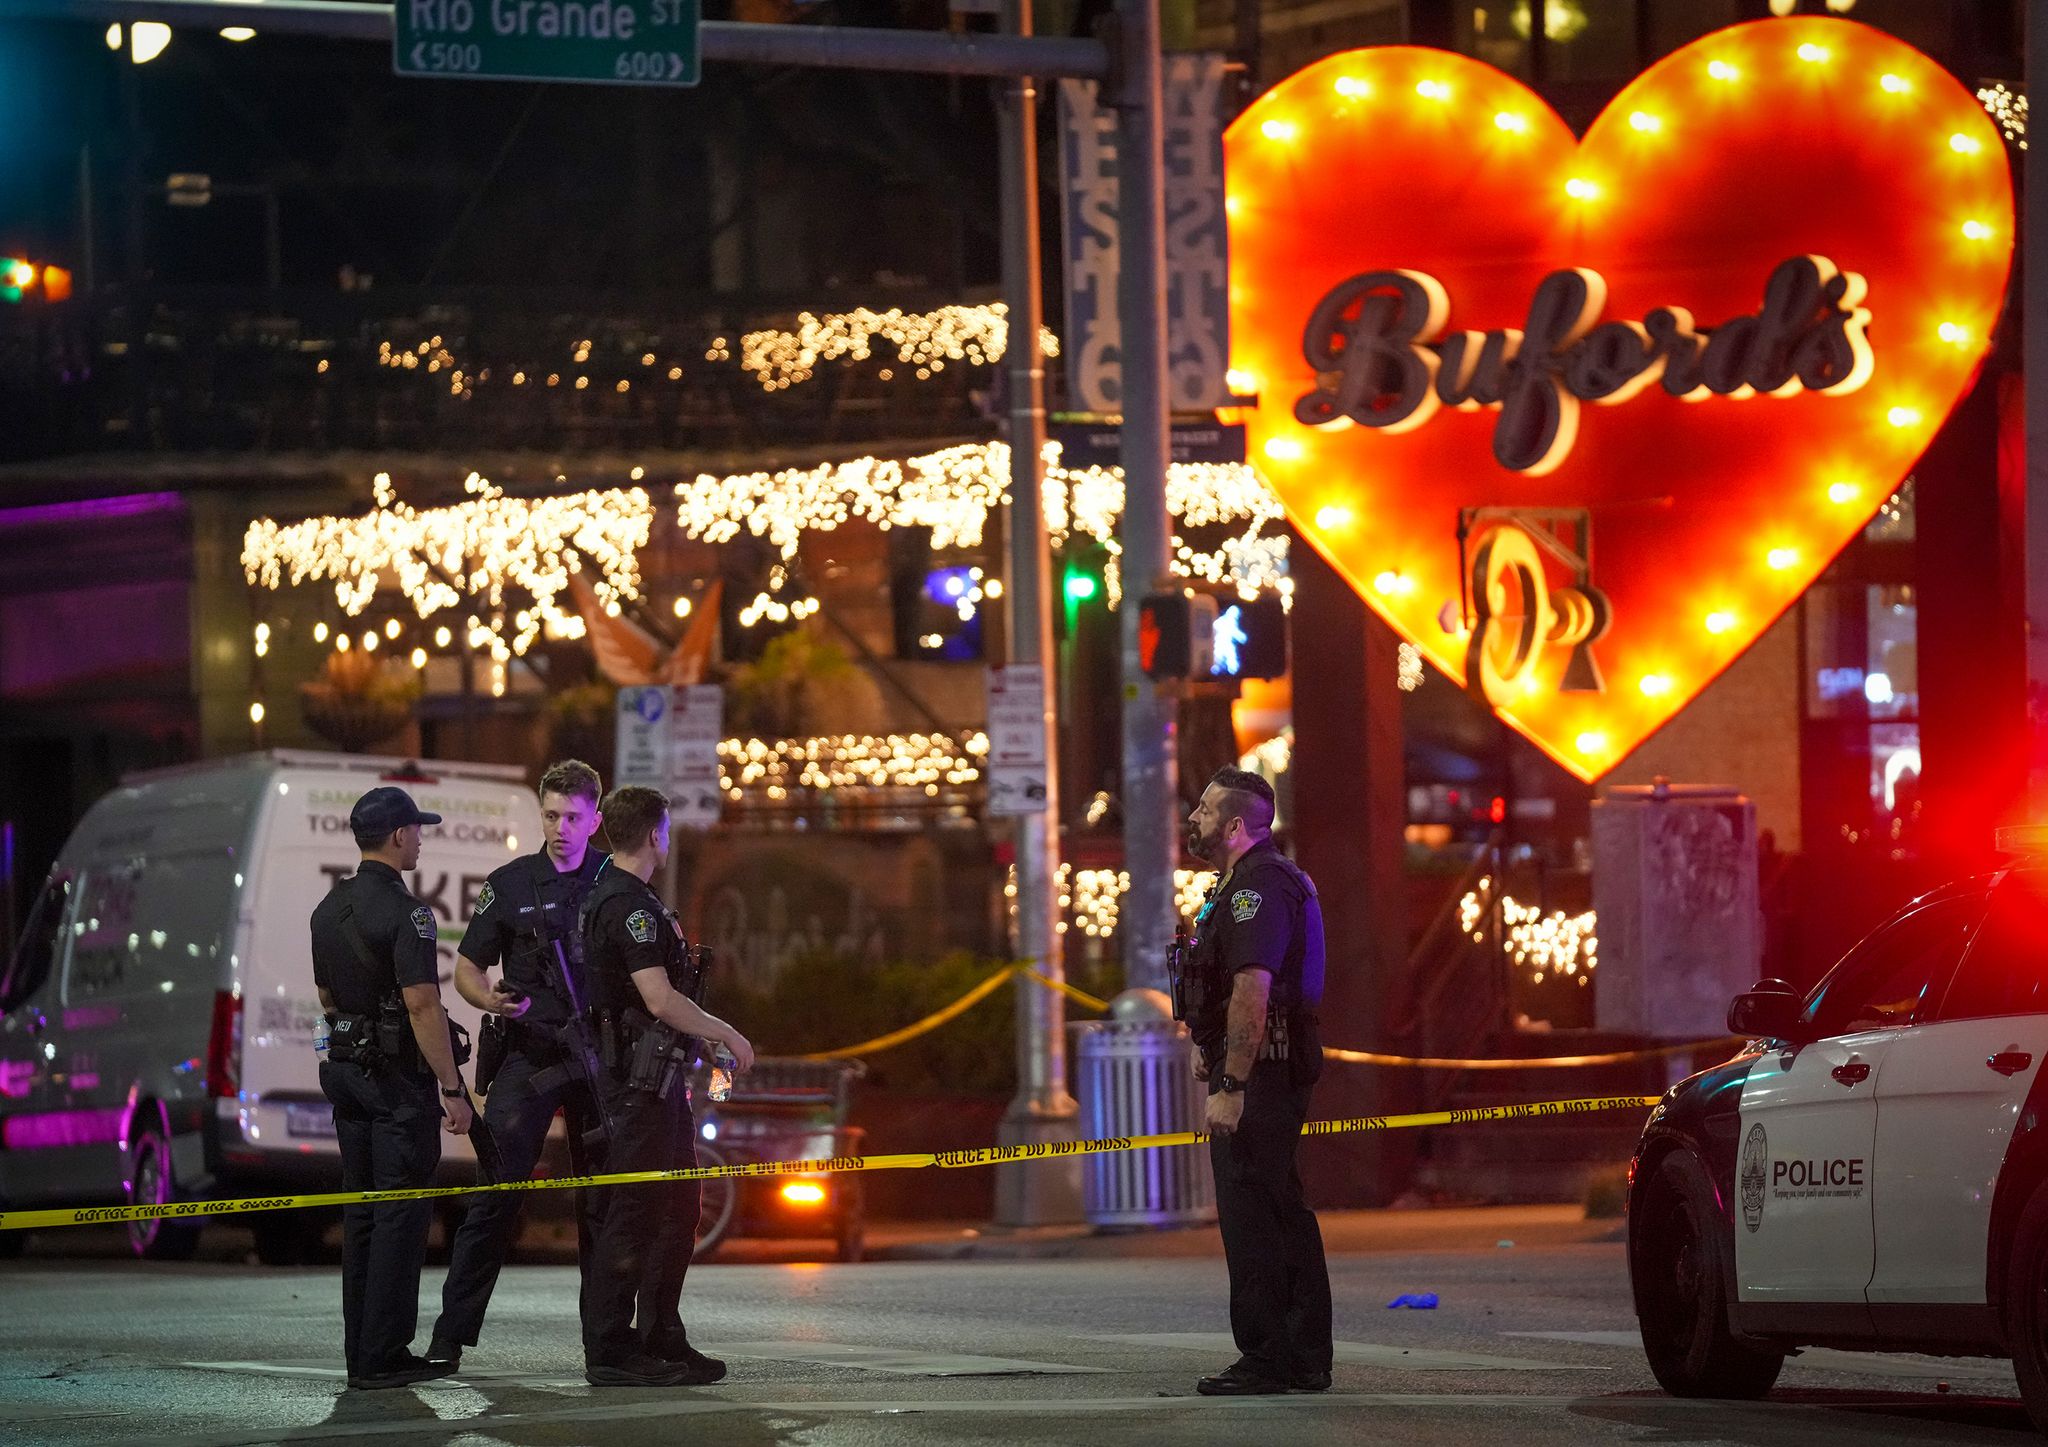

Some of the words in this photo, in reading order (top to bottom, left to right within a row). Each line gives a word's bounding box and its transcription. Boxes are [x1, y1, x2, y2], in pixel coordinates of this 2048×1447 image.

[410, 0, 474, 32] Rio
[491, 0, 636, 39] Grande
[651, 0, 682, 25] ST
[431, 43, 482, 72] 500
[615, 51, 665, 79] 600
[1294, 254, 1875, 477] Buford's
[307, 790, 361, 805] SAM
[334, 1020, 351, 1032] MED
[1450, 1108, 1499, 1123] POLICE
[1503, 1105, 1535, 1119] LINE
[1539, 1103, 1559, 1115] DO
[1563, 1101, 1593, 1113] NOT
[935, 1149, 985, 1166] POLICE
[989, 1146, 1021, 1161] LINE
[1050, 1142, 1078, 1154] NOT
[1773, 1159, 1864, 1187] POLICE
